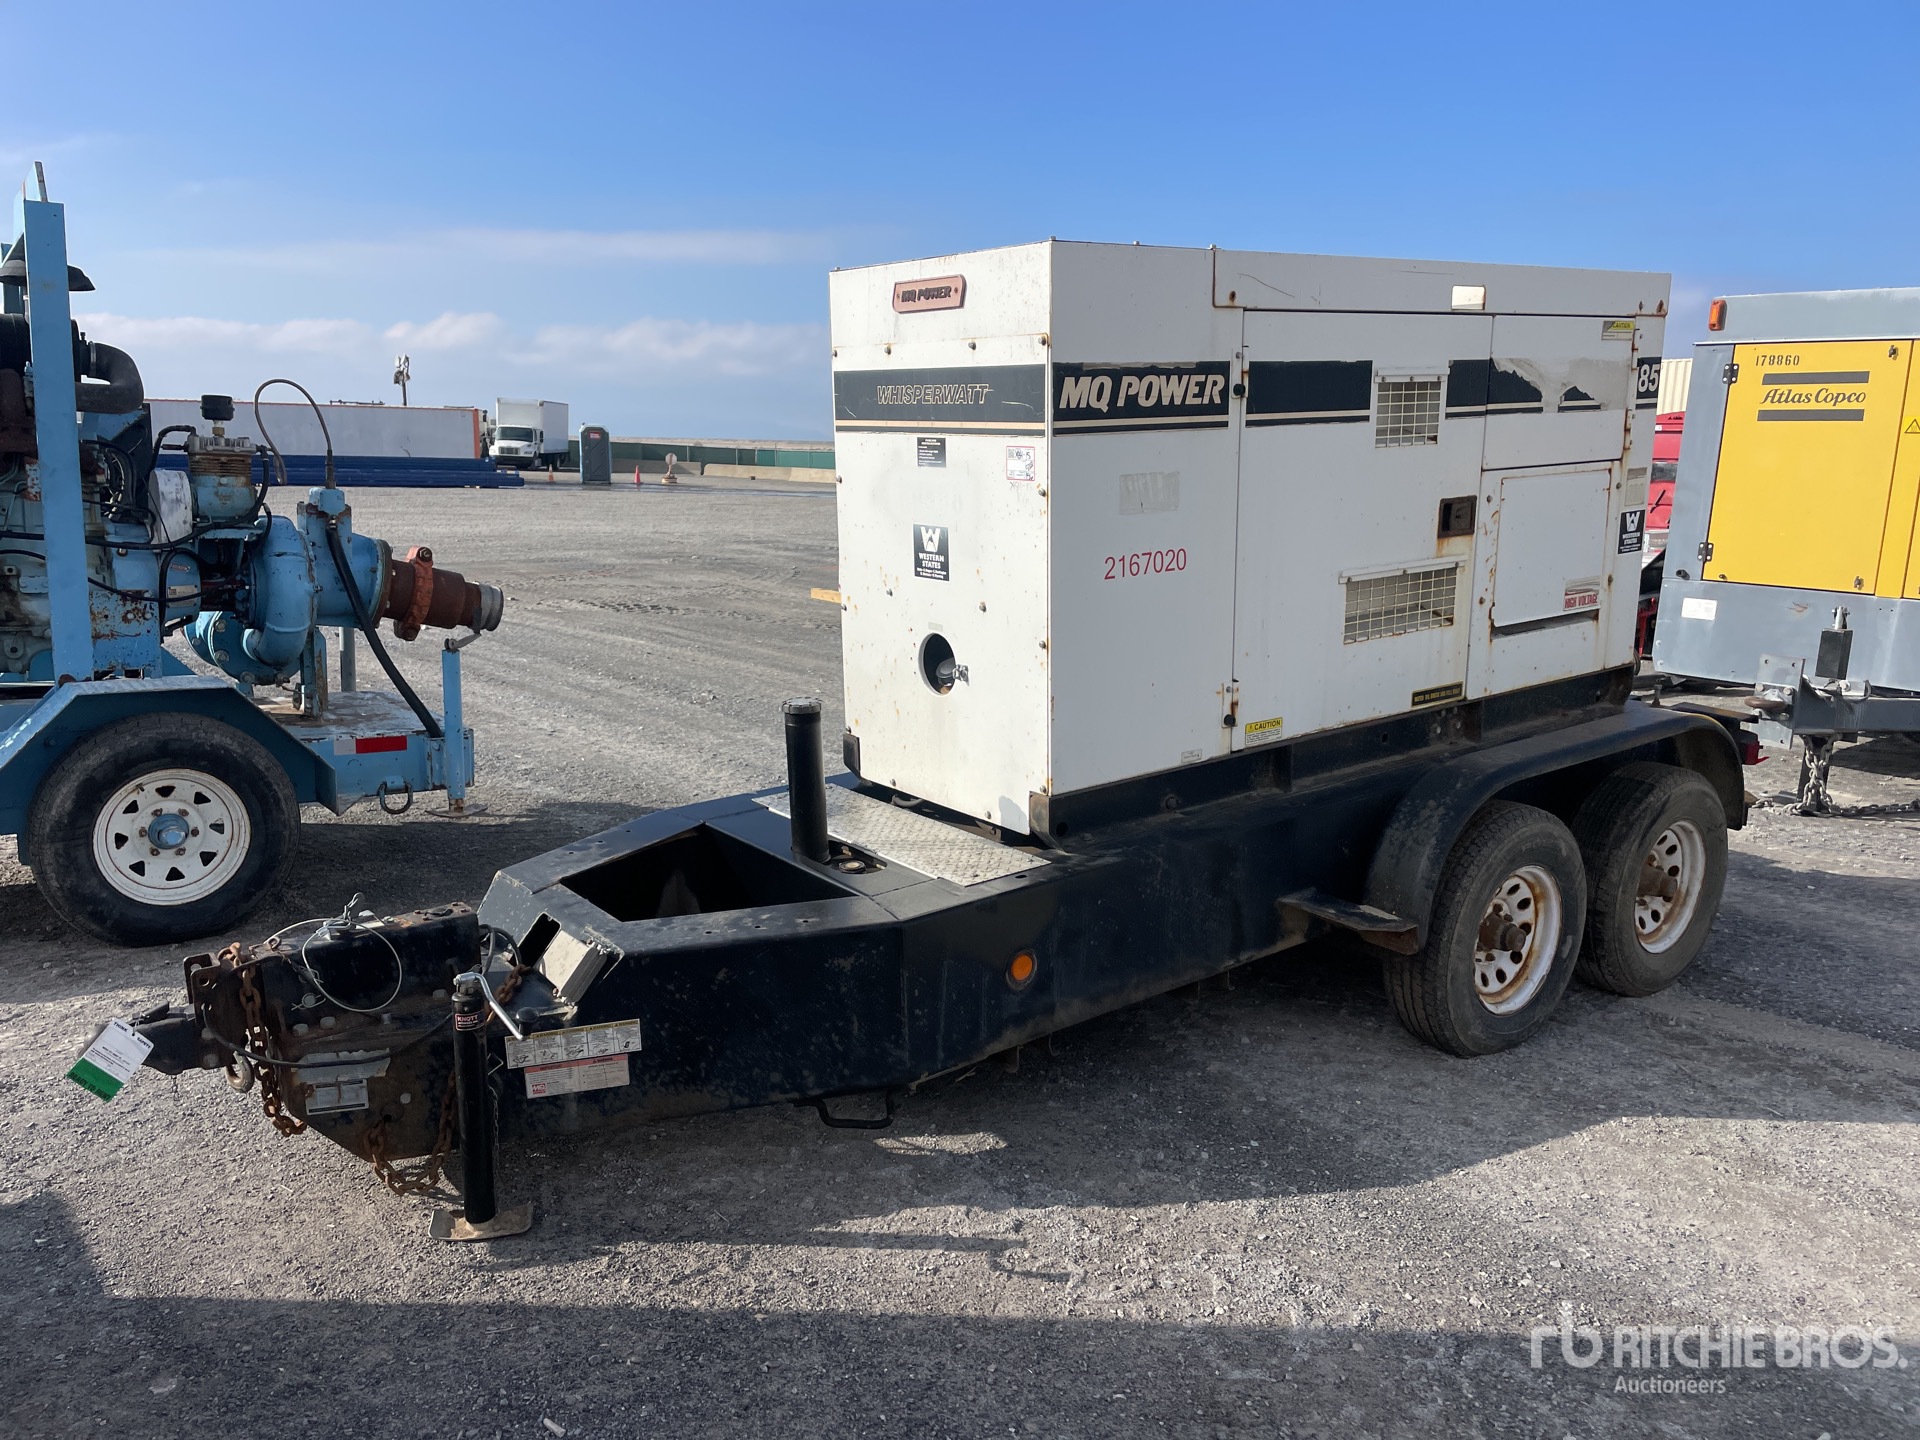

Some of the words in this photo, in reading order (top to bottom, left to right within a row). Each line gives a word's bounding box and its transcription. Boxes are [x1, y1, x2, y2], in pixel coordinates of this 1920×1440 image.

[901, 289, 917, 302] MQ
[917, 285, 952, 301] POWER
[1756, 355, 1800, 366] 178860
[877, 384, 990, 405] WHISPERWATT
[1059, 375, 1113, 413] MQ
[1117, 374, 1225, 408] POWER
[1760, 388, 1813, 404] Atlas
[1814, 387, 1867, 407] Copco
[918, 552, 945, 562] WESTERN
[922, 560, 942, 569] STATES
[1104, 548, 1187, 580] 2167020
[1254, 719, 1281, 731] CAUTION
[457, 1014, 479, 1022] KNOTT
[113, 1021, 129, 1033] THINK
[137, 1037, 151, 1049] SAFETY
